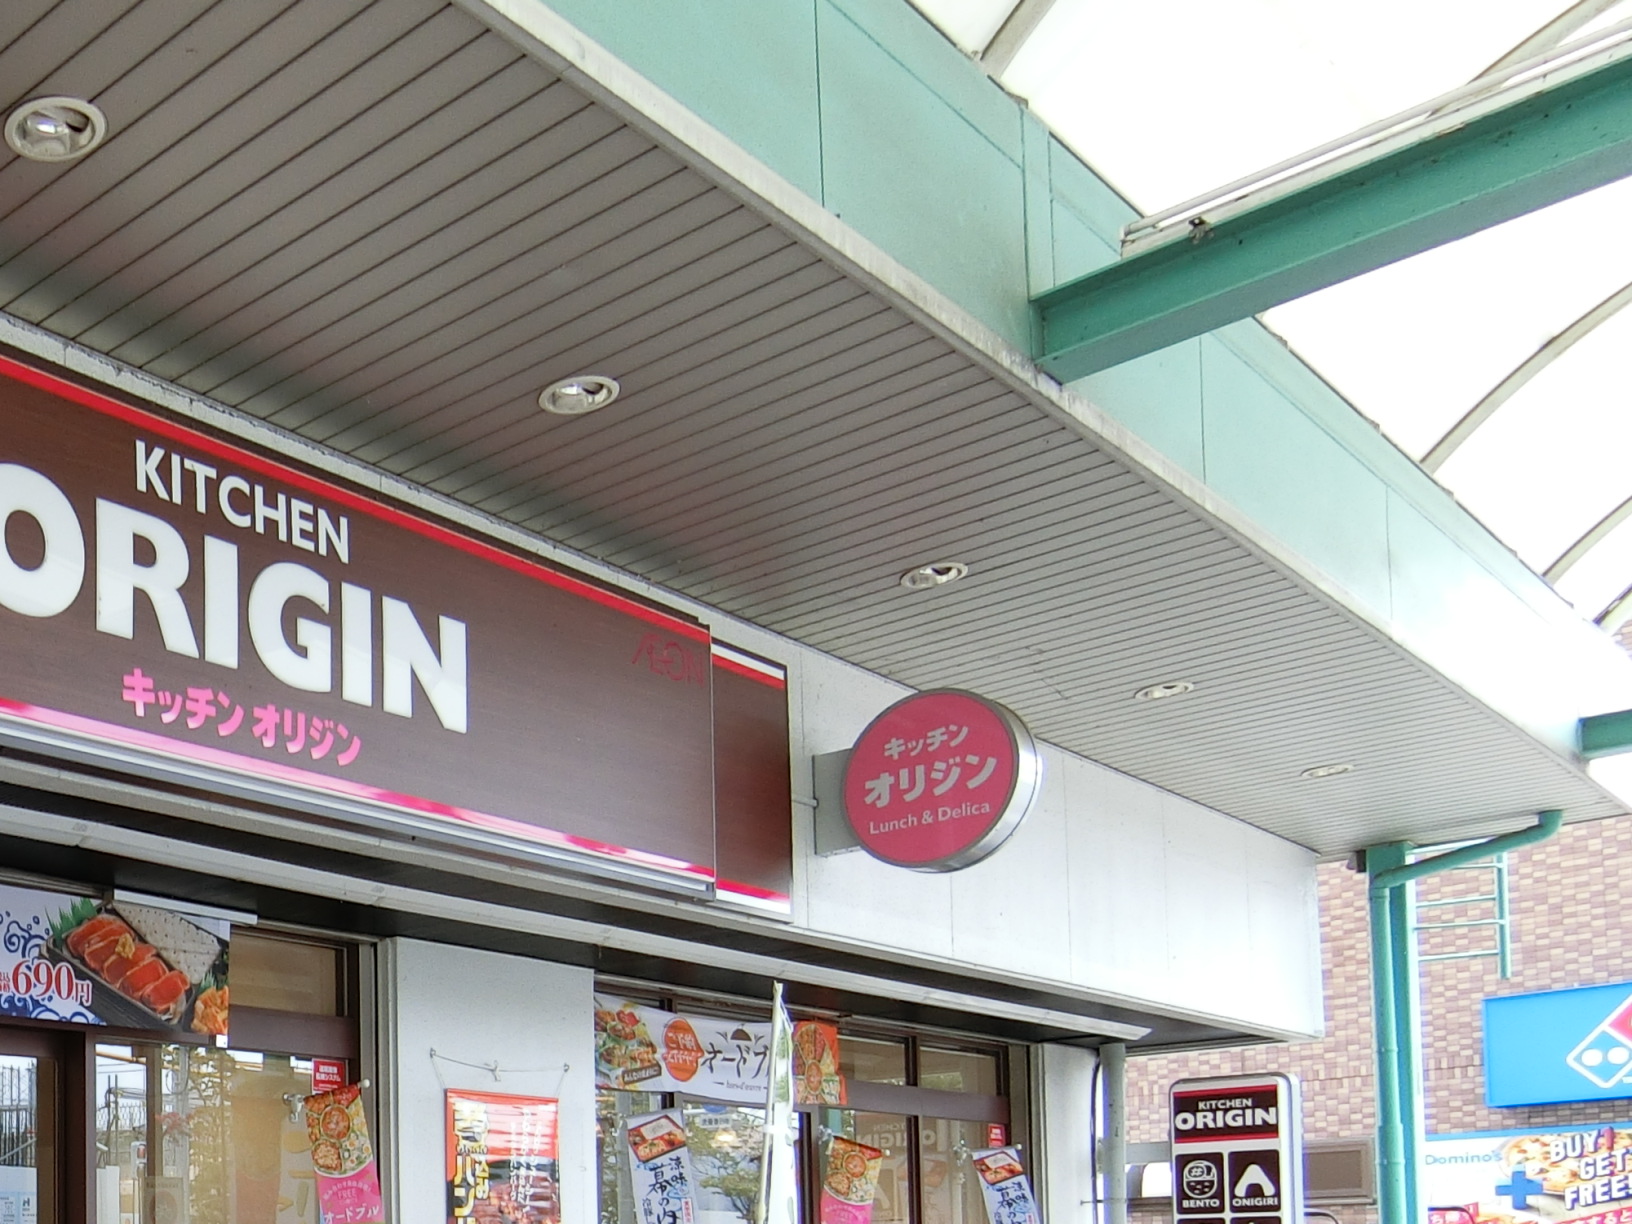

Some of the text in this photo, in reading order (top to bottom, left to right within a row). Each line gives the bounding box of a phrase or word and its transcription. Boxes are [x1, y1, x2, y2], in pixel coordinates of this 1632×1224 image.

[135, 438, 350, 564] KITCHEN
[121, 666, 362, 766] キッチン オリジン
[883, 724, 969, 761] キッチン
[864, 754, 998, 809] オリジン
[869, 802, 991, 835] Lunch & Delica
[11, 960, 93, 1006] 690円
[701, 1042, 768, 1079] オードブ
[1174, 1107, 1278, 1131] ORIGIN
[1198, 1098, 1253, 1111] KITCHEN
[1425, 1150, 1503, 1166] Domino's
[1549, 1130, 1599, 1163] BUY
[1579, 1148, 1628, 1181] GET
[324, 1202, 380, 1224] オードブル
[1182, 1197, 1279, 1209] BENTO ONIGIRI
